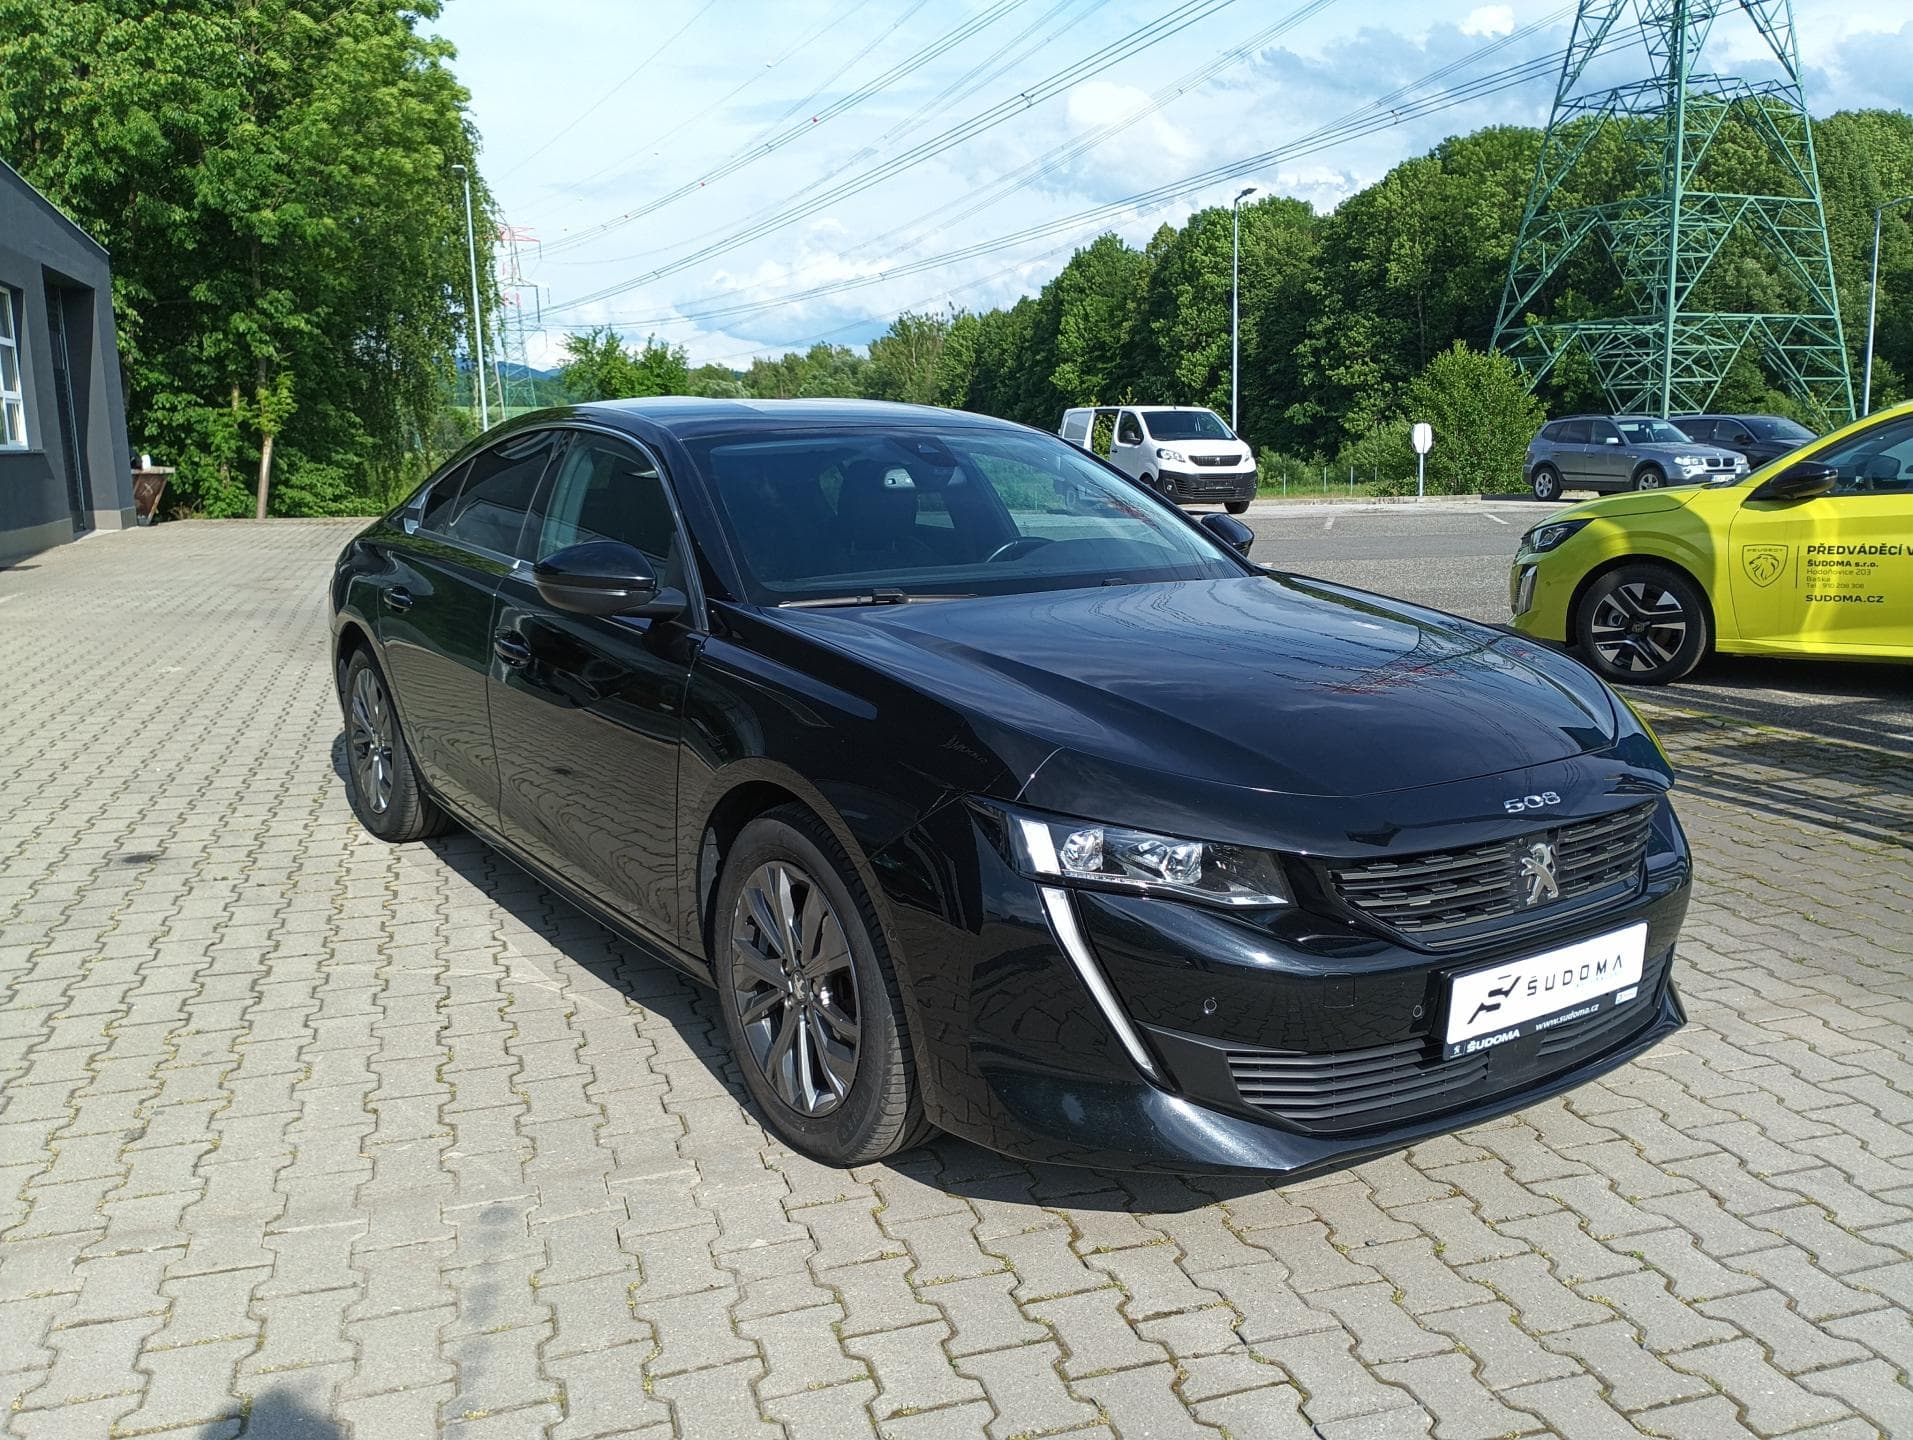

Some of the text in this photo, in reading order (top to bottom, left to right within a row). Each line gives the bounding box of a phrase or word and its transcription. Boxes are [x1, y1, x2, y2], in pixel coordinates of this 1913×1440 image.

[1806, 542, 1903, 556] PŘEDVÁDĚCÍ
[1807, 558, 1852, 567] ŠUDOMA
[1805, 594, 1885, 603] SUDOMA.CZ
[1503, 791, 1561, 813] 508
[1535, 1003, 1600, 1031] www.sudoma.cz
[1466, 1028, 1520, 1053] ŠUDOMA
